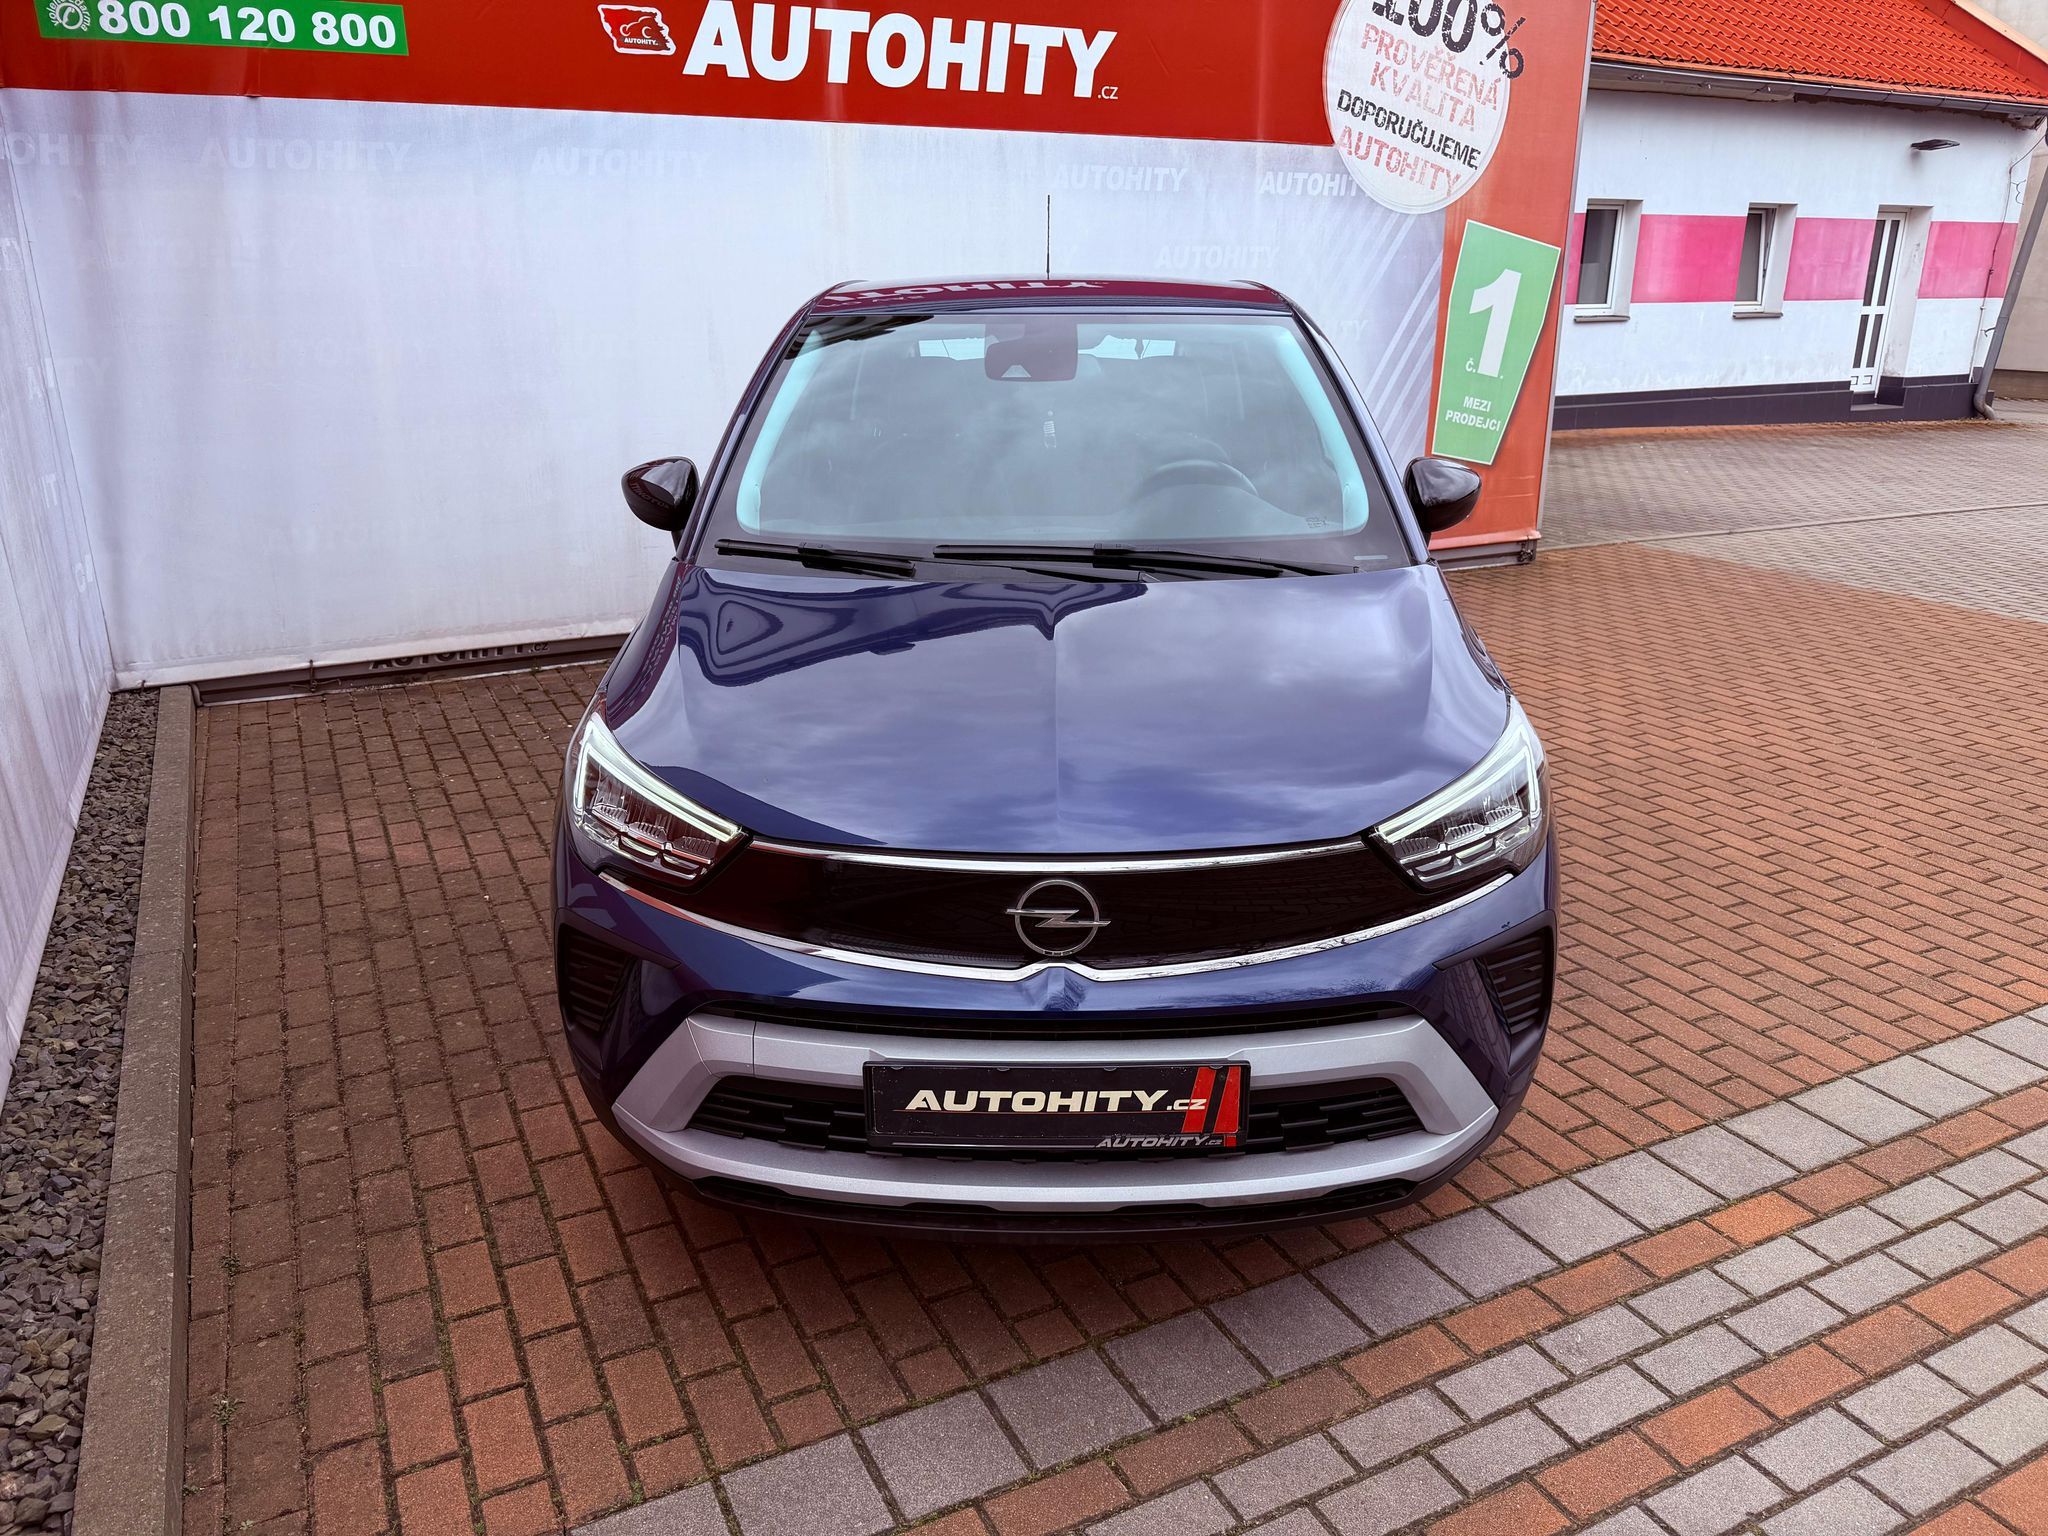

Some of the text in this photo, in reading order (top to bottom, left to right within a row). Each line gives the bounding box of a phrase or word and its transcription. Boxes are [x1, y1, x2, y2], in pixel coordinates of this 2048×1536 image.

[97, 0, 396, 49] 800 120 800
[1361, 23, 1502, 110] PROVĚŘENÁ
[1370, 61, 1476, 132] KVALITA
[1337, 89, 1482, 170] DOPORUČUJEME
[199, 137, 412, 172] AUTOHITY
[530, 146, 712, 178] AUTOHITY
[1337, 126, 1462, 198] AUTOHITY
[1049, 163, 1188, 192] AUTOHITY
[1153, 244, 1281, 270] AUTOHITY
[1463, 396, 1492, 412] MEZI
[1445, 410, 1502, 432] PRODEJCI
[905, 1089, 1207, 1113] AUTOHITY.cz
